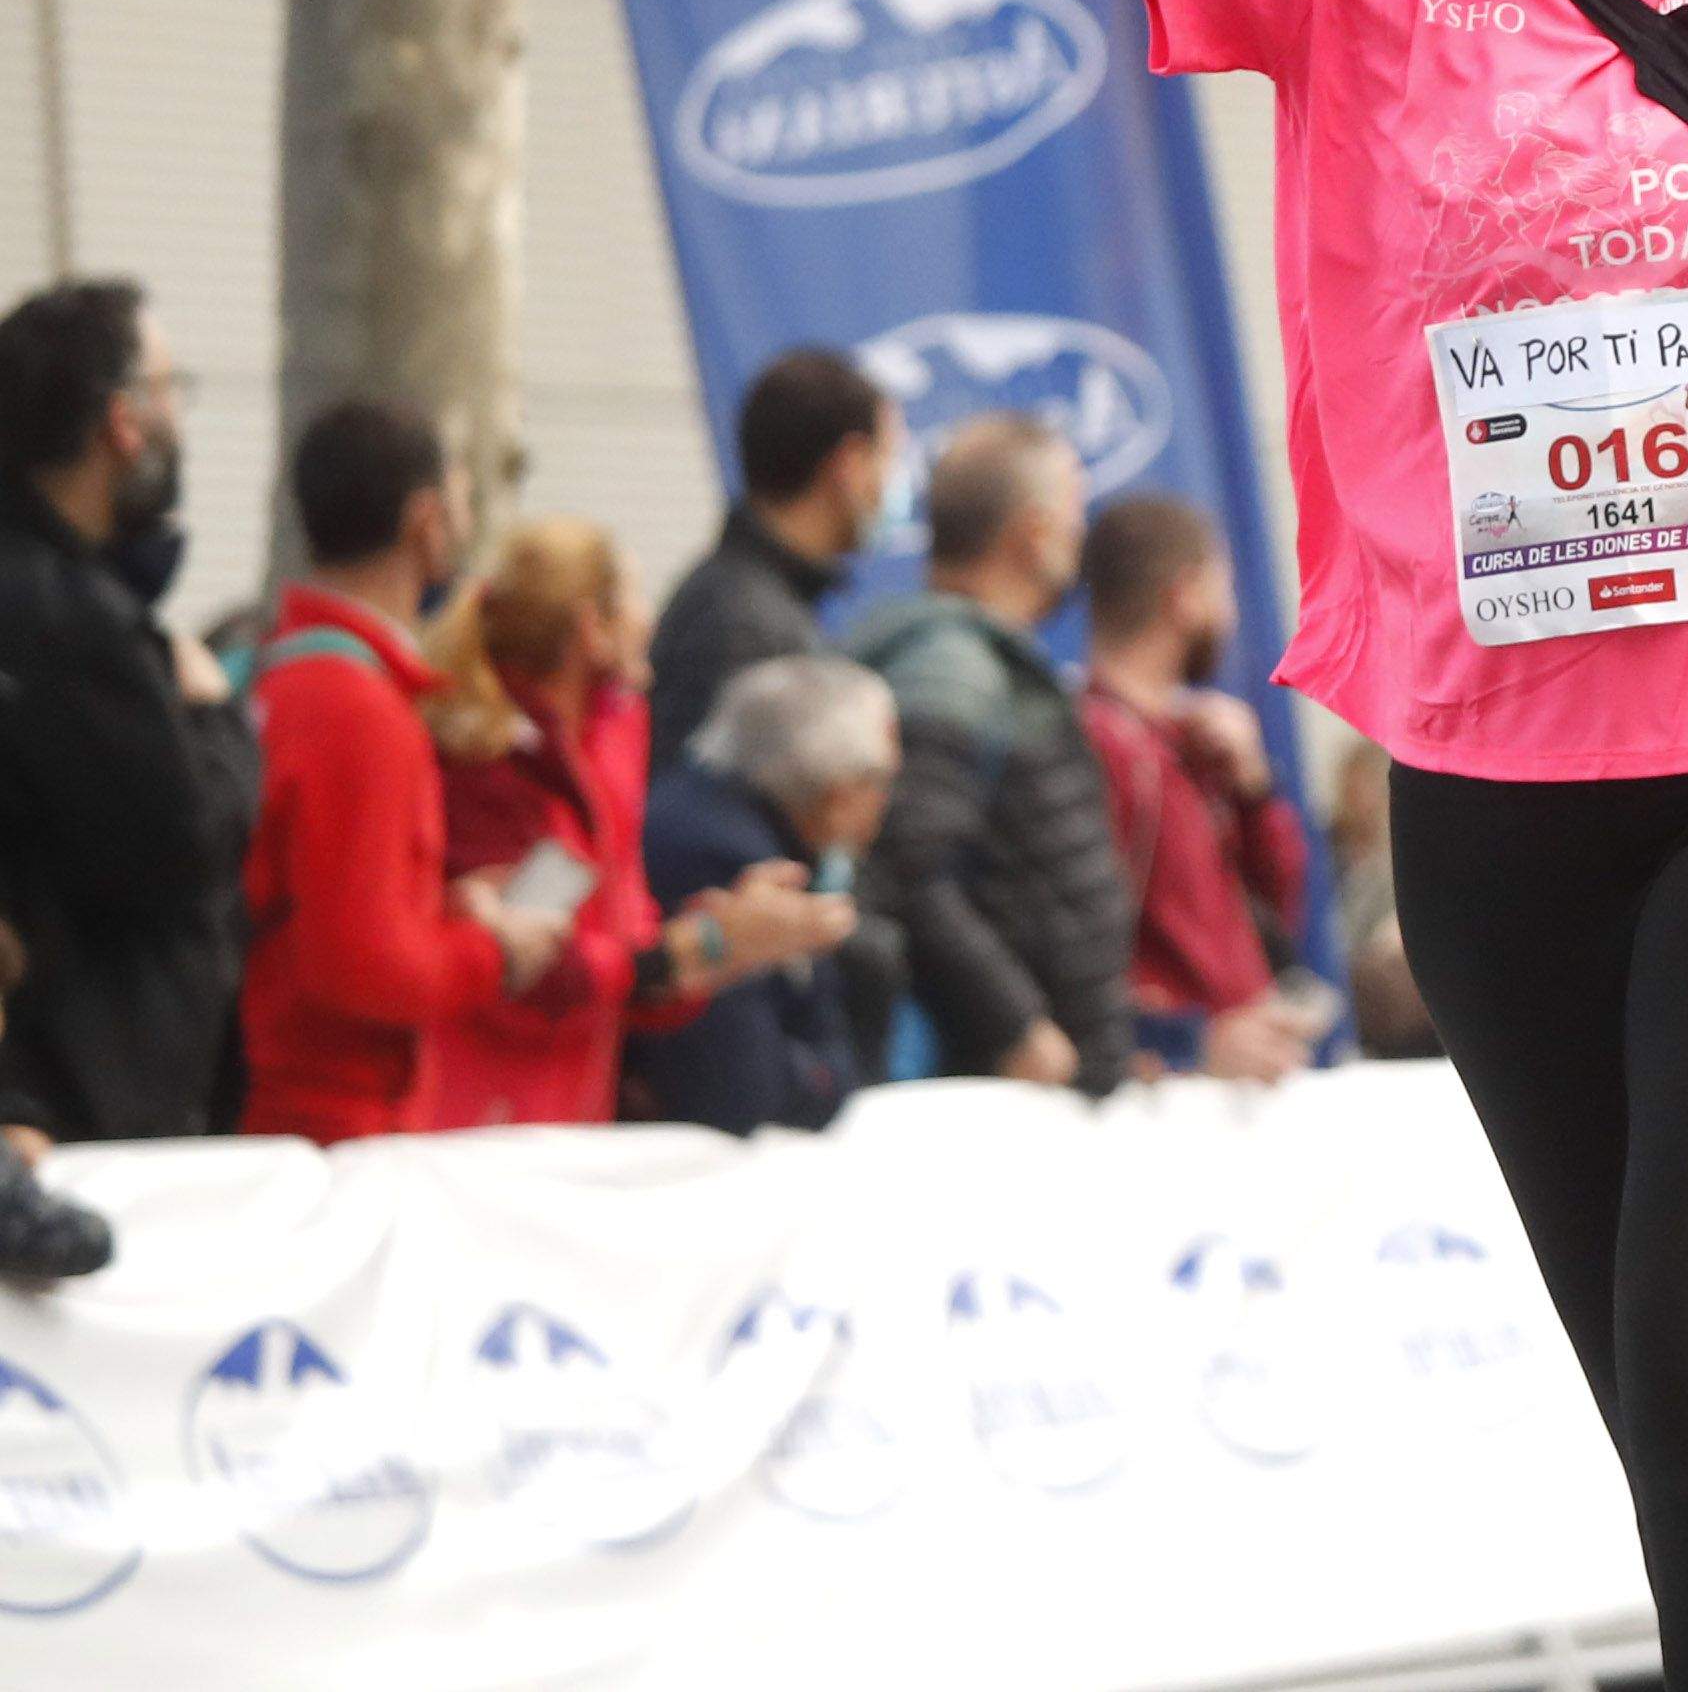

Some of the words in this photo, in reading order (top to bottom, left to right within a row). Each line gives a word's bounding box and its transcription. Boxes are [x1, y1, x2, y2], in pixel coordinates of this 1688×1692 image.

[1450, 344, 1504, 389] VA
[1519, 336, 1590, 381] POR
[1587, 497, 1655, 529] 1641
[1471, 549, 1524, 574] CURSA
[1528, 546, 1550, 565] DE
[1555, 541, 1587, 561] LES
[1592, 533, 1651, 556] DONES
[1657, 529, 1681, 548] DE
[1476, 586, 1575, 622] OYSHO
[1611, 580, 1665, 598] Santander
